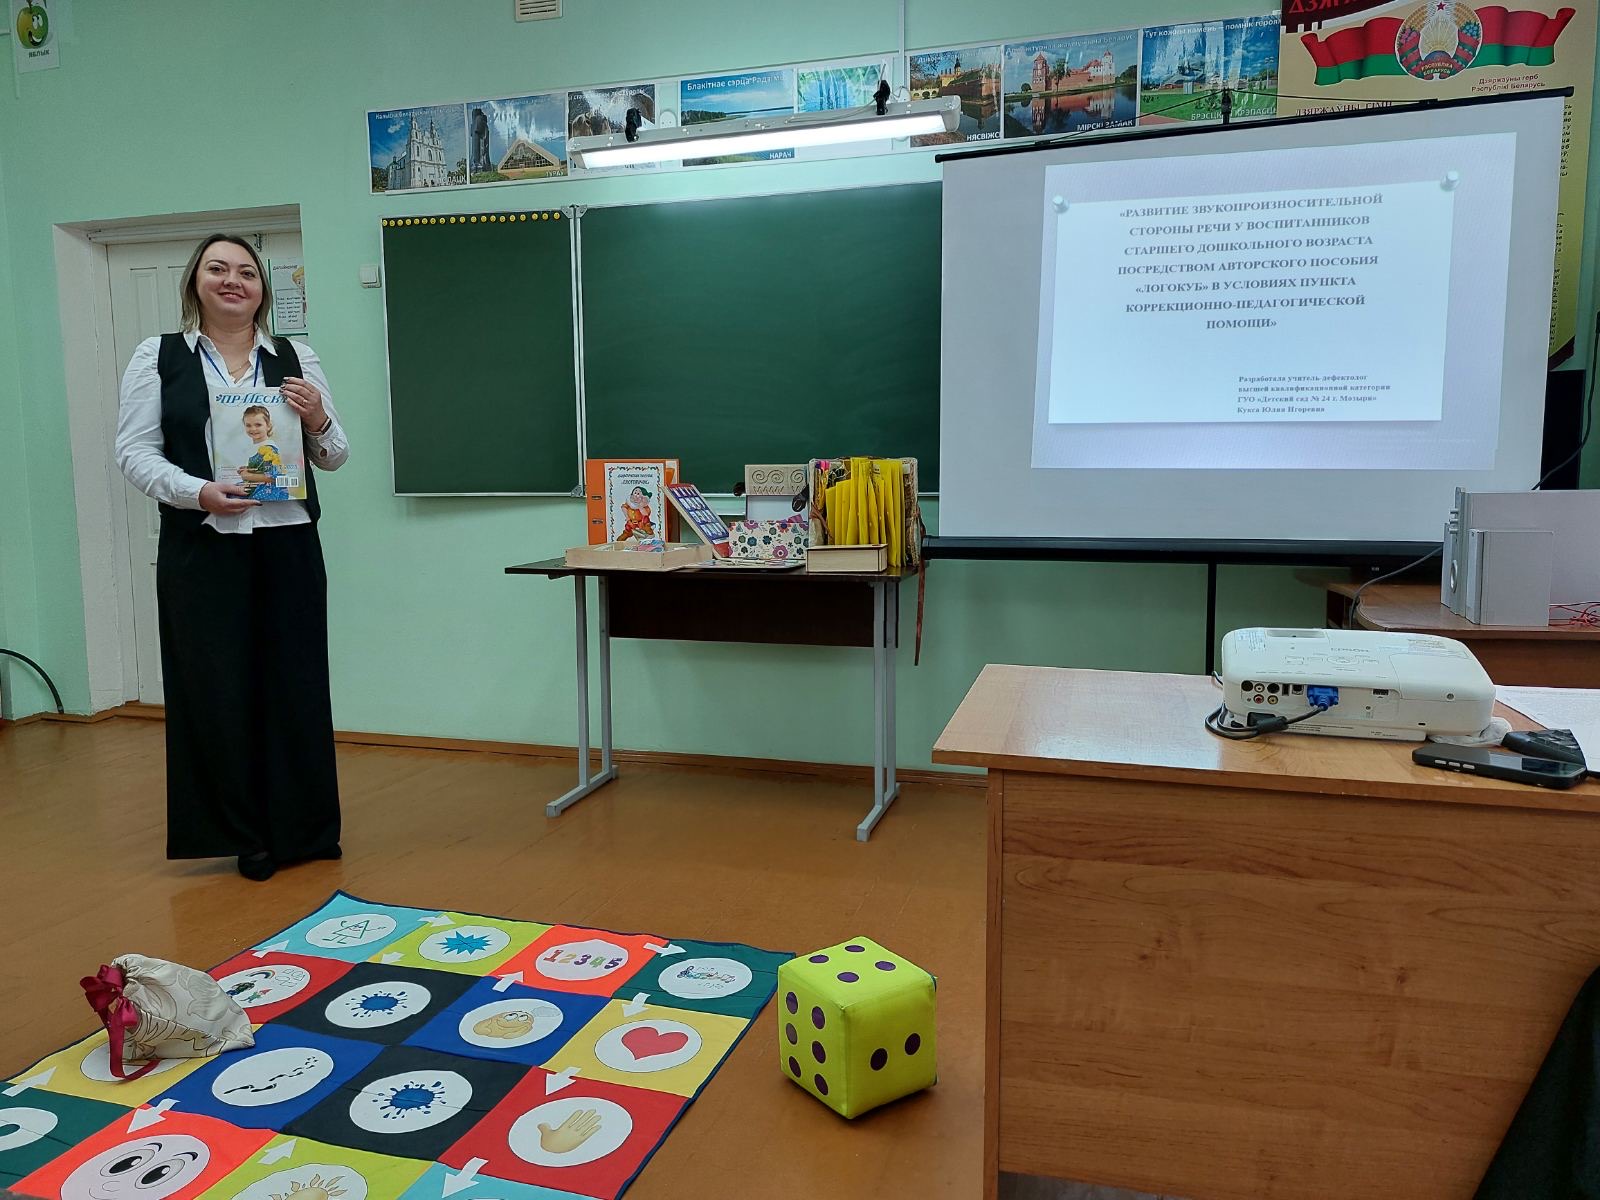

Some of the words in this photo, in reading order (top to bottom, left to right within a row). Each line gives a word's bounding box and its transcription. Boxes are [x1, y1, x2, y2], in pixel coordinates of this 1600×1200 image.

[687, 80, 726, 92] Блакітнае
[769, 150, 792, 160] НАРАЧ
[1119, 205, 1189, 218] «РАЗВИТИЕ
[1192, 193, 1384, 215] ЗВУКОПРОИЗНОСИТЕЛЬНОЙ
[1129, 224, 1194, 237] СТОРОНЫ
[1197, 222, 1232, 234] РЕЧИ
[1235, 221, 1244, 231] У
[1247, 215, 1371, 231] ВОСПИТАННИКОВ
[1124, 244, 1195, 256] СТАРШЕГО
[1197, 238, 1303, 255] ДОШКОЛЬНОГО
[1306, 235, 1374, 248] ВОЗРАСТА
[1118, 262, 1216, 276] ПОСРЕДСТВОМ
[1218, 258, 1308, 272] АВТОРСКОГО
[1310, 255, 1380, 267] ПОСОБИЯ
[1135, 281, 1209, 294] «ЛОГОКУБ»
[1211, 280, 1221, 291] В
[1223, 277, 1298, 291] УСЛОВИЯХ
[1300, 276, 1357, 288] ПУНКТА
[1125, 294, 1367, 313] КОРРЕКЦИОННО-ПЕДАГОГИЧЕСКОЙ
[1206, 317, 1278, 329] ПОМОЩИ»
[1271, 384, 1348, 393] квалификационной
[1350, 384, 1392, 392] категории
[1237, 395, 1256, 404] ГУО
[1287, 405, 1326, 414] Игоревна
